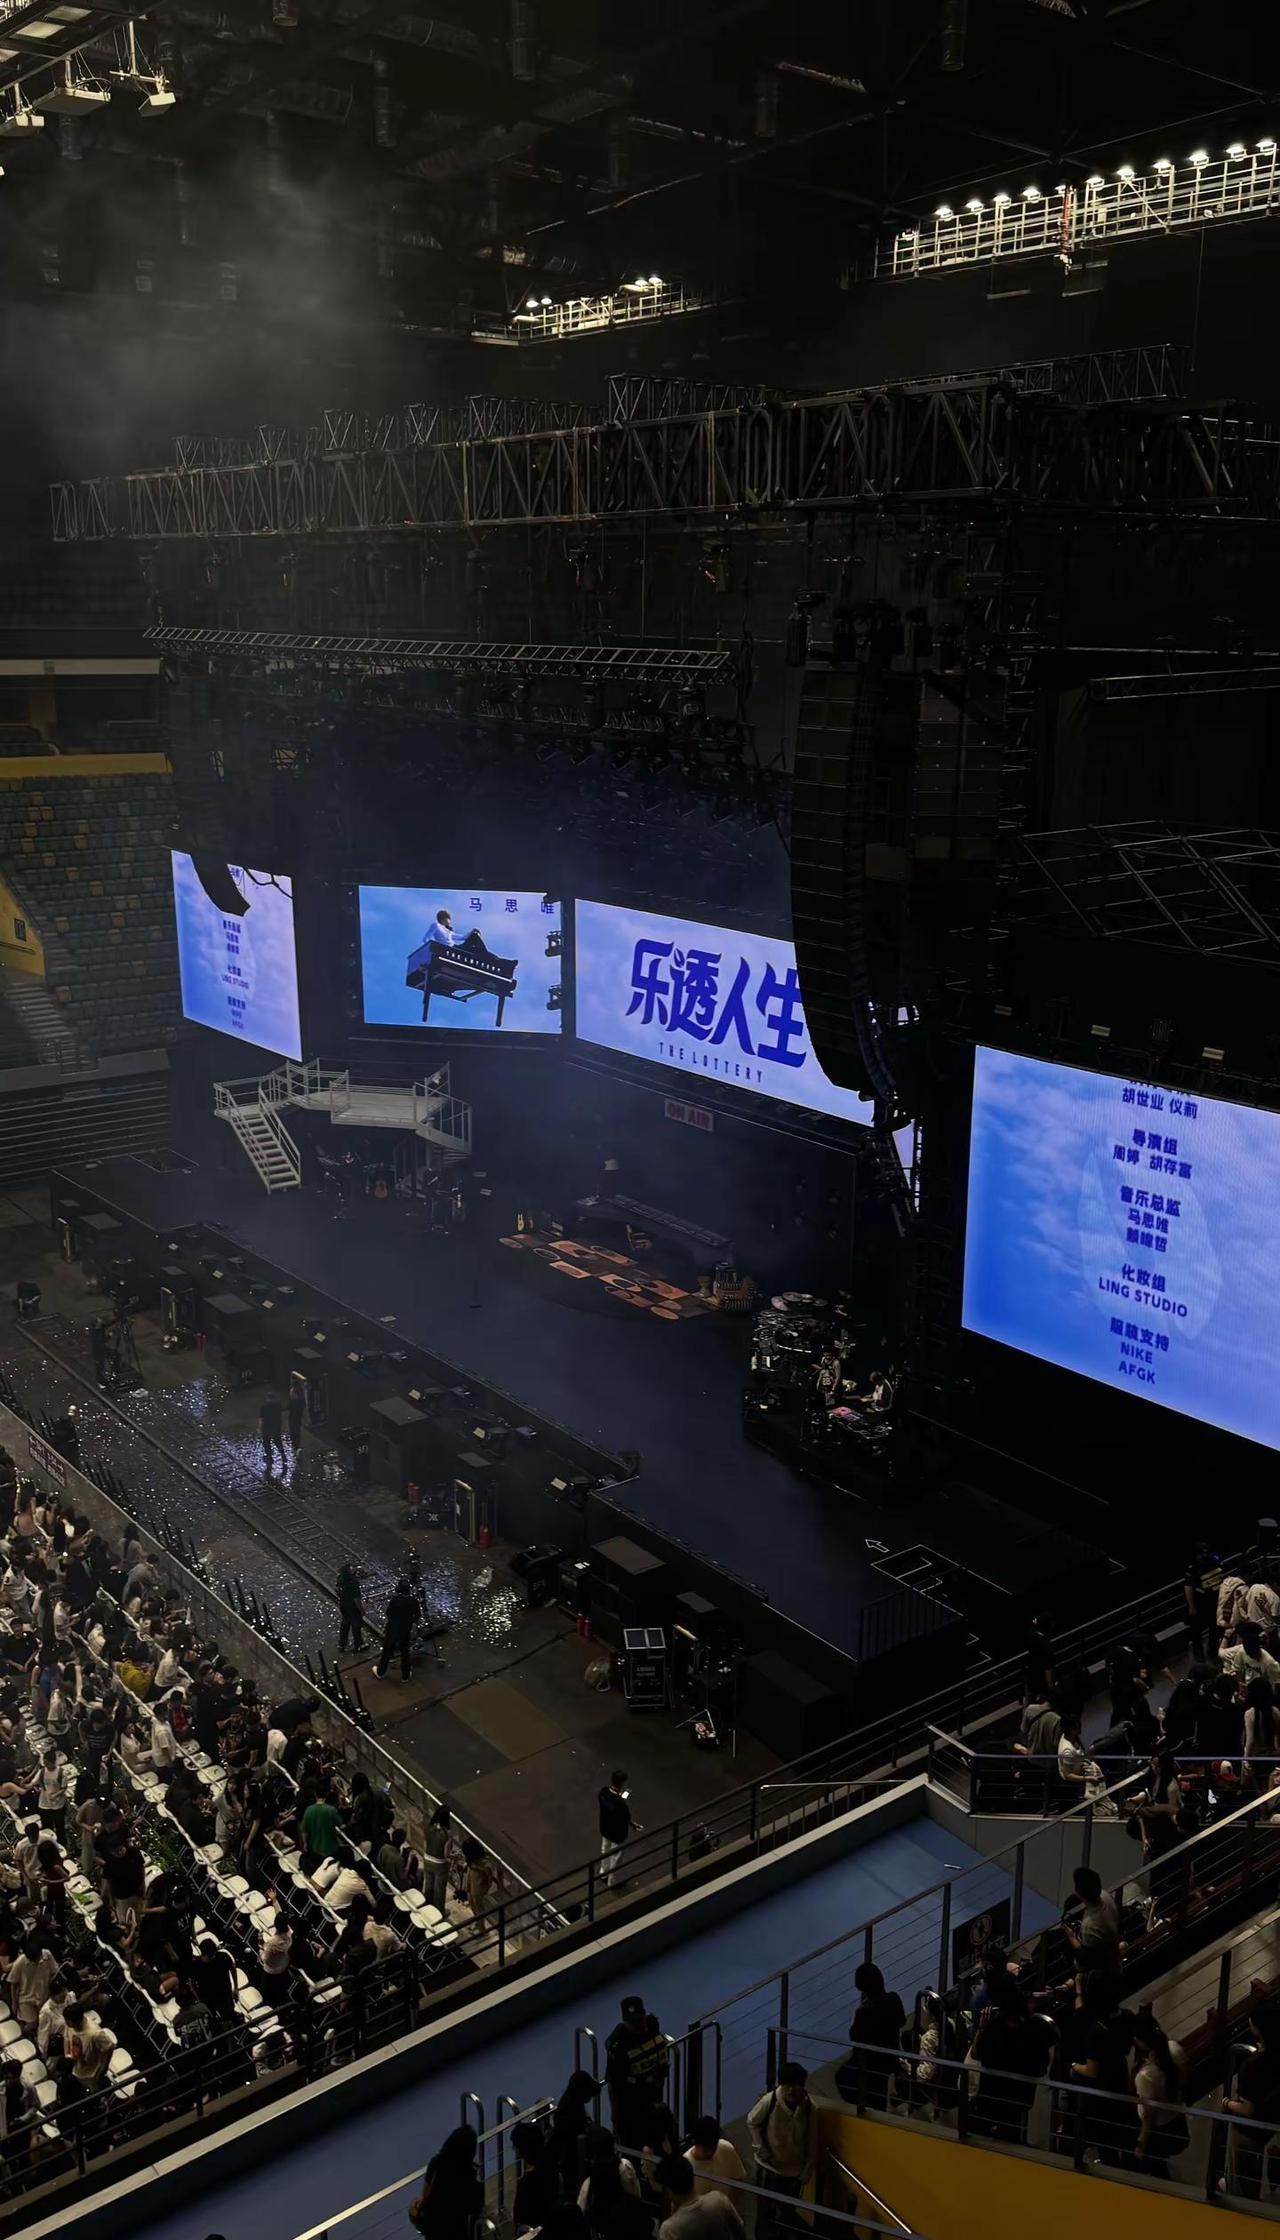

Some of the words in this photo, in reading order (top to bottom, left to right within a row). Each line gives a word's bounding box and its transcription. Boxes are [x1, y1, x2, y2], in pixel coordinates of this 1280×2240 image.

[625, 938, 808, 1069] 乐透人生
[659, 1041, 684, 1061] THE
[692, 1051, 762, 1083] LOTTERY
[667, 1102, 685, 1120] ON
[687, 1108, 710, 1129] AIR
[1132, 1128, 1178, 1156] 导演组
[1121, 1185, 1181, 1218] 音乐总监
[1128, 1207, 1169, 1234] 马思唯
[1121, 1263, 1166, 1293] 化妆组
[1098, 1276, 1130, 1299] LING
[1134, 1289, 1188, 1318] STUDIO
[1120, 1341, 1153, 1364] NIKE
[1118, 1360, 1156, 1385] AFGK
